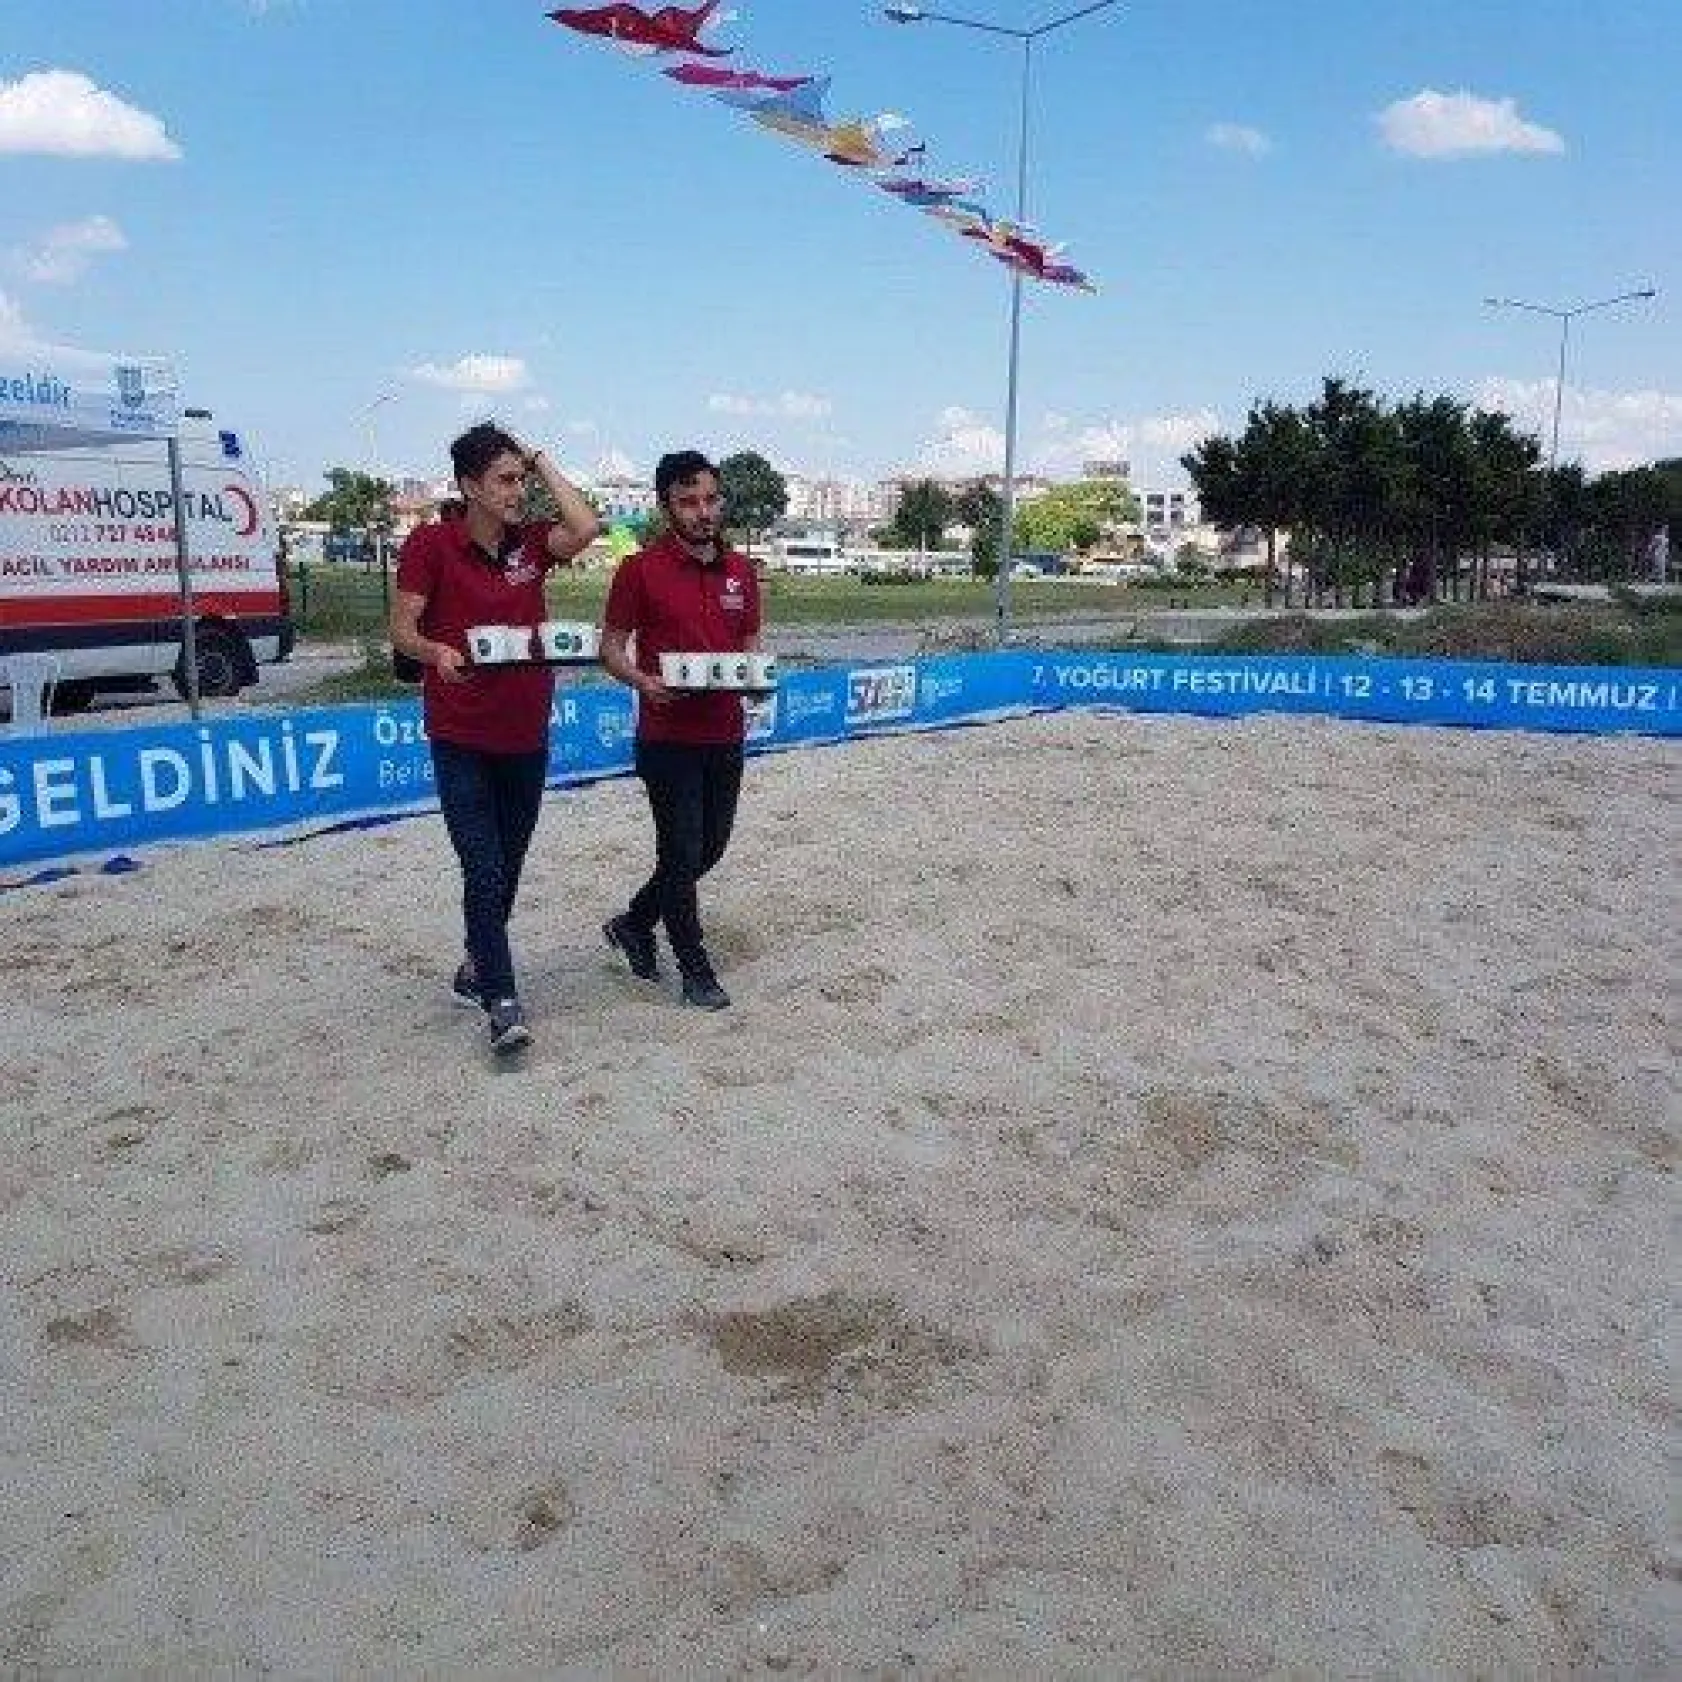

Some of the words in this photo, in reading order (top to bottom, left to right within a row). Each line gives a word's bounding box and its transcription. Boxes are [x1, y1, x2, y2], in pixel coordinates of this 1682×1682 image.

[0, 373, 70, 406] zeldir
[1054, 662, 1166, 690] YOĞURT
[1173, 665, 1316, 694] FESTİVALİ
[1340, 675, 1373, 697] 12
[1400, 675, 1434, 701] 13
[1463, 678, 1497, 703] 14
[1507, 680, 1657, 711] TEMMUZ
